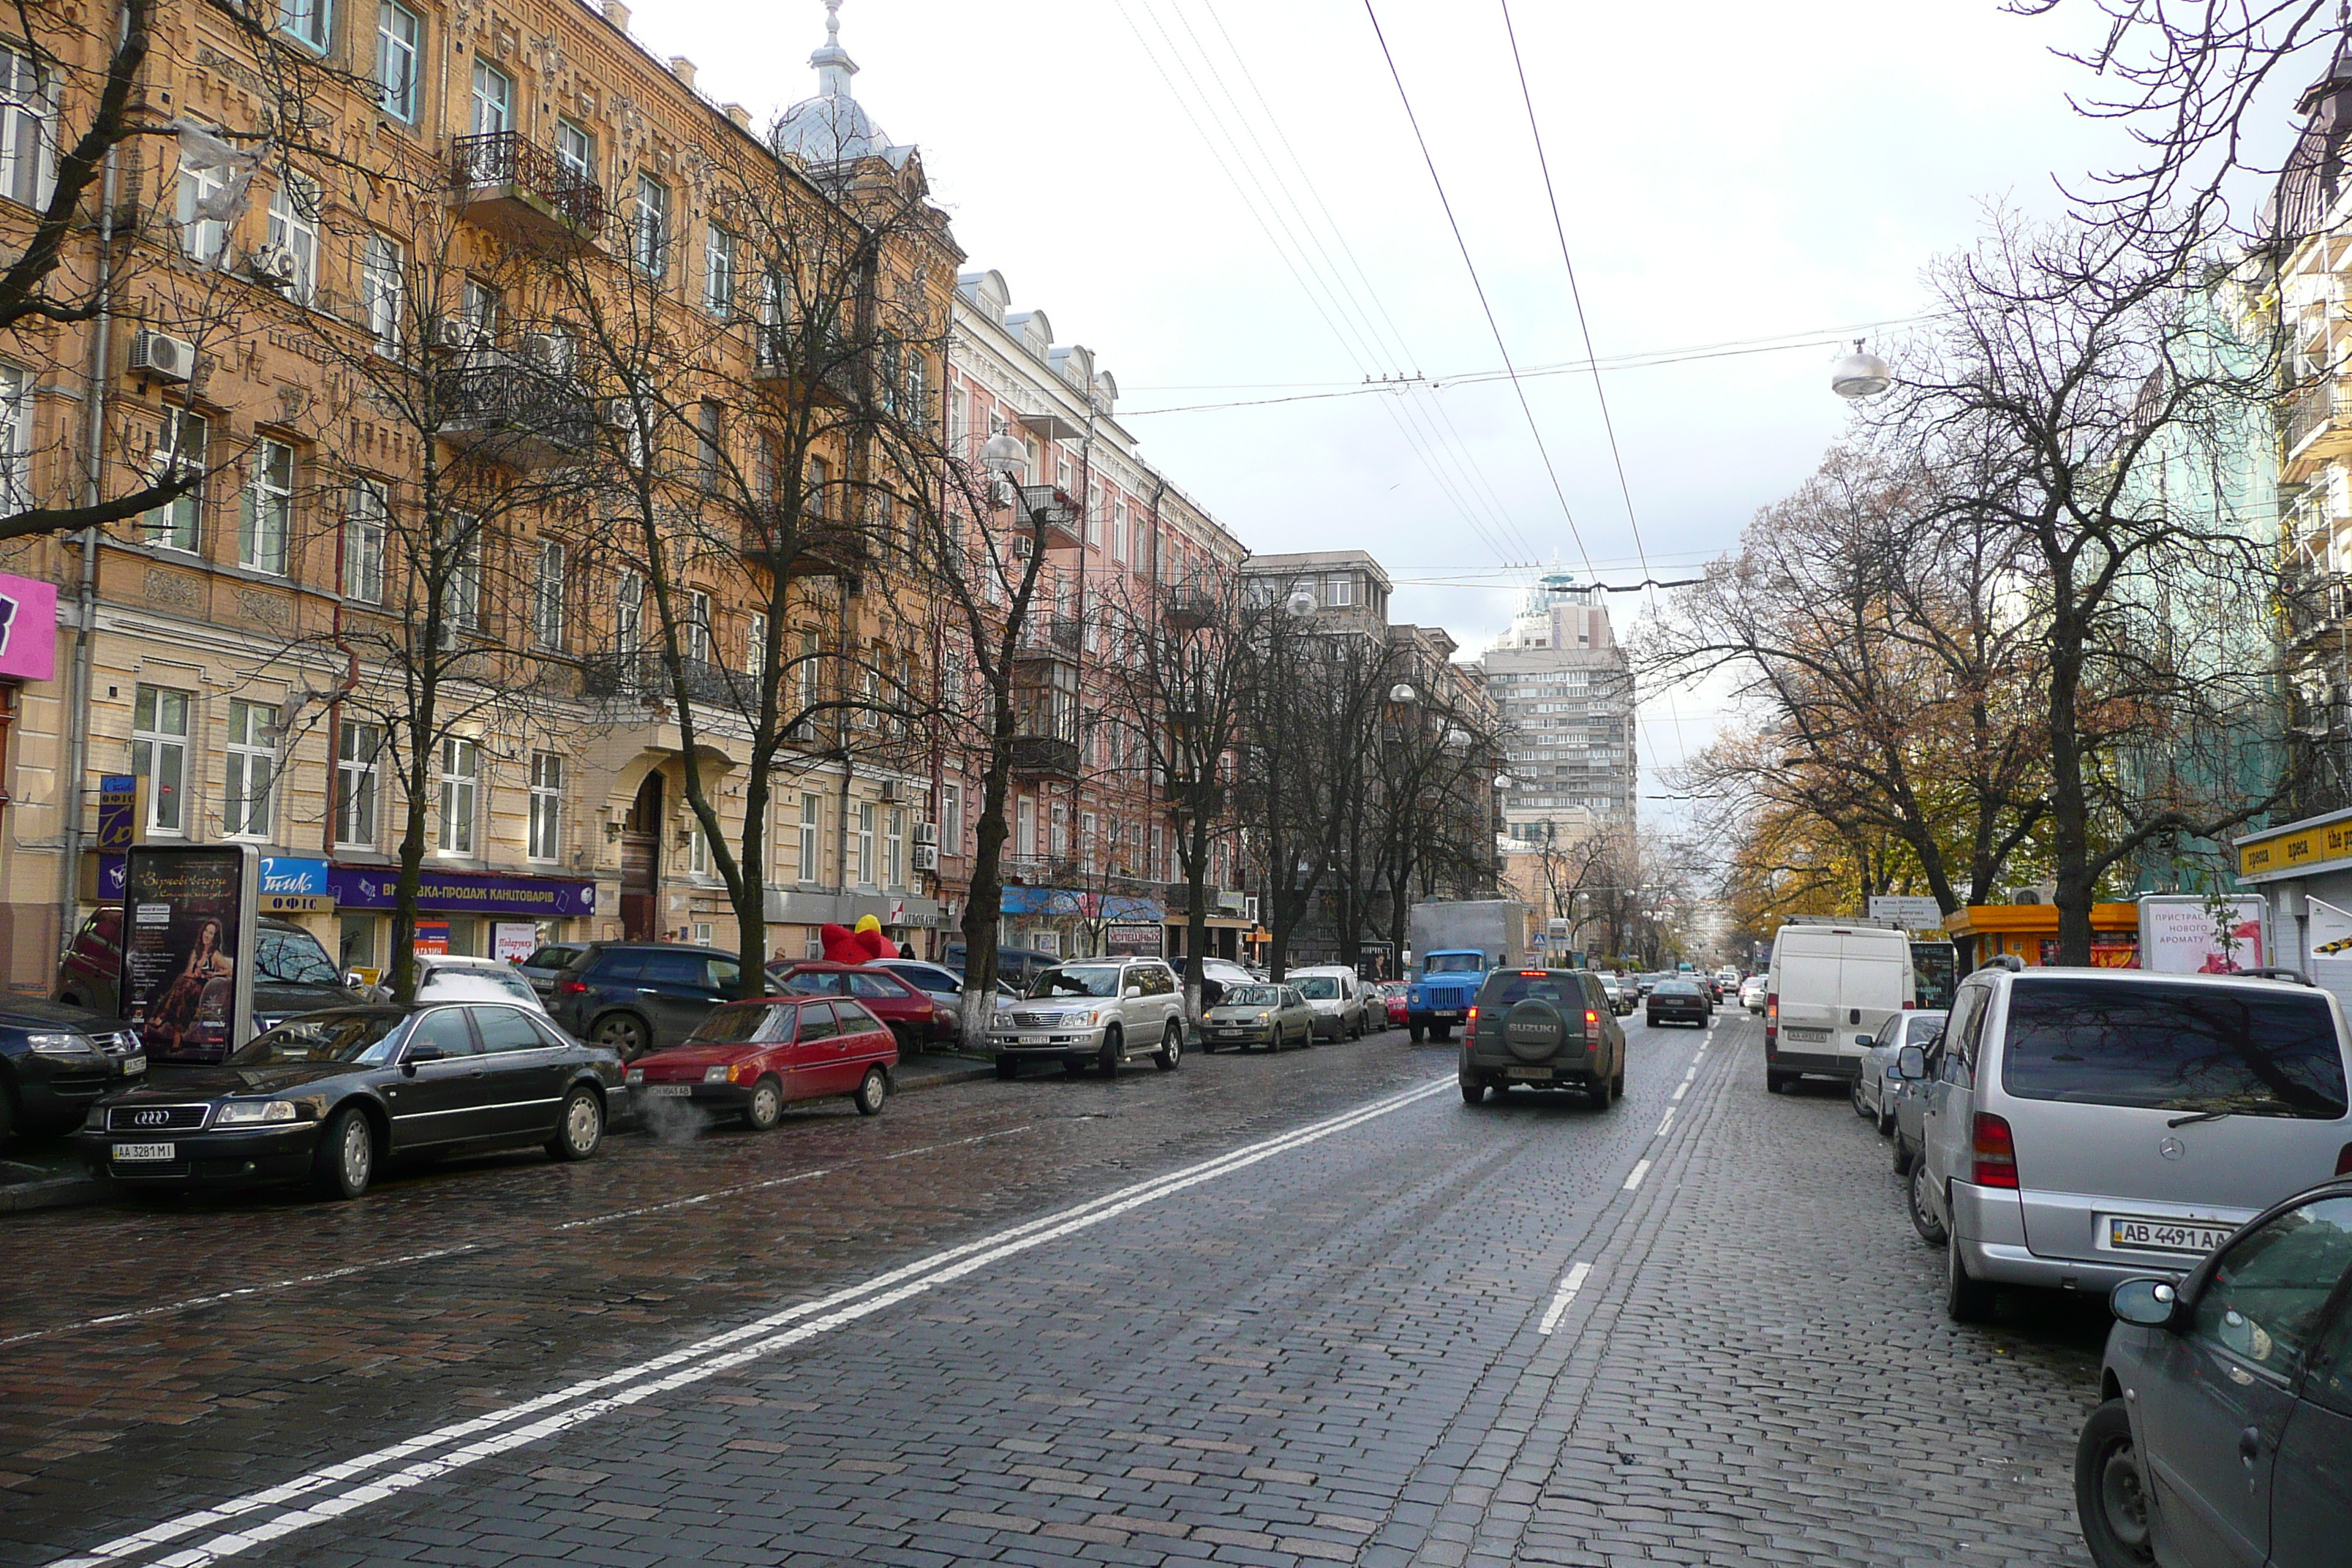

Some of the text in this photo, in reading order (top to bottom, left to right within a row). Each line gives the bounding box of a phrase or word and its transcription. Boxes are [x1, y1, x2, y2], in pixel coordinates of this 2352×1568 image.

[2328, 830, 2342, 849] the
[2288, 840, 2308, 860] преса
[2248, 849, 2269, 869] пресса
[490, 887, 554, 902] КАНЦТОВАРІВ
[273, 897, 317, 910] ОФІС
[2155, 913, 2215, 921] ПРИСТРАСТЬ
[2169, 924, 2208, 932] НОВОГО
[1109, 932, 1160, 941] УСПЕШНЫХ
[1361, 946, 1391, 954] ЮРИСТ
[1509, 1023, 1556, 1033] SUZUKI
[119, 1145, 170, 1157] AA 3281 MI
[2125, 1224, 2227, 1248] AB 4491 AA
